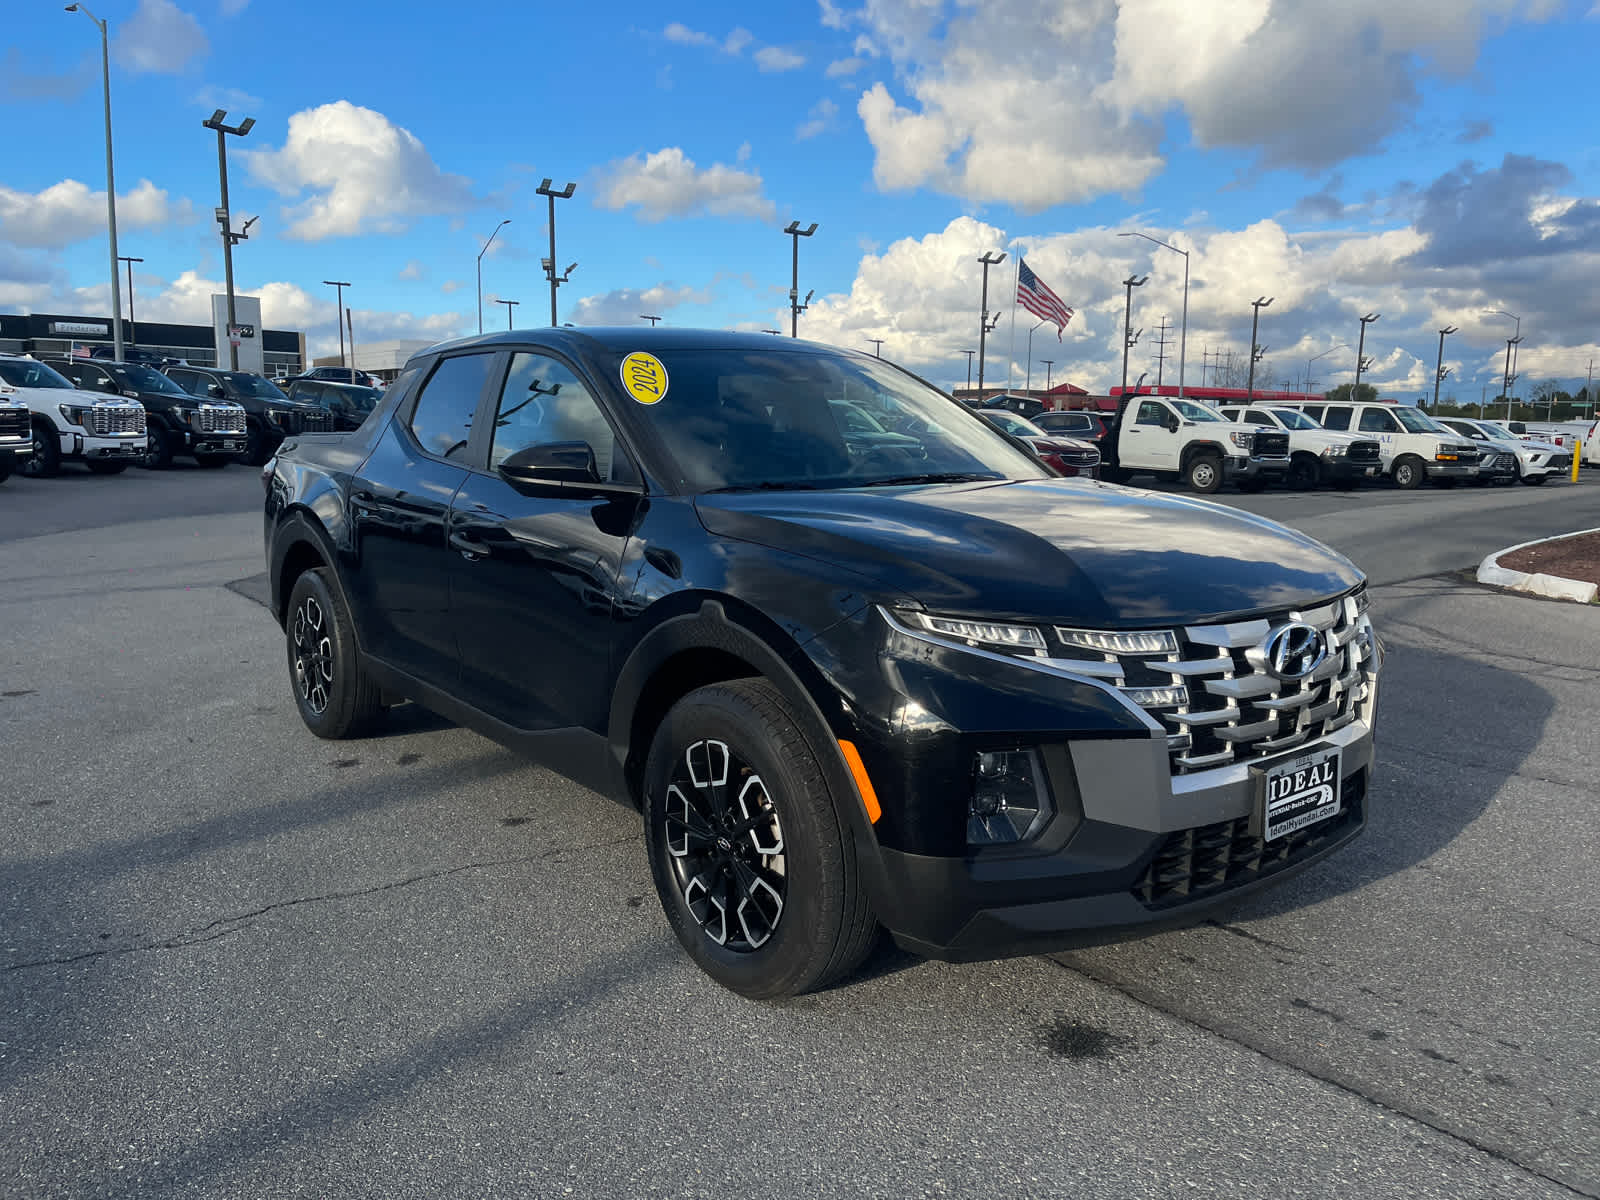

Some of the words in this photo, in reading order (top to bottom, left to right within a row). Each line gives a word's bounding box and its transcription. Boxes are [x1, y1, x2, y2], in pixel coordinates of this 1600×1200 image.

[630, 358, 659, 394] 2024
[1296, 755, 1313, 763] IDEAL
[1270, 762, 1334, 801] IDEAL
[1270, 806, 1335, 837] IdealHyundai.com
